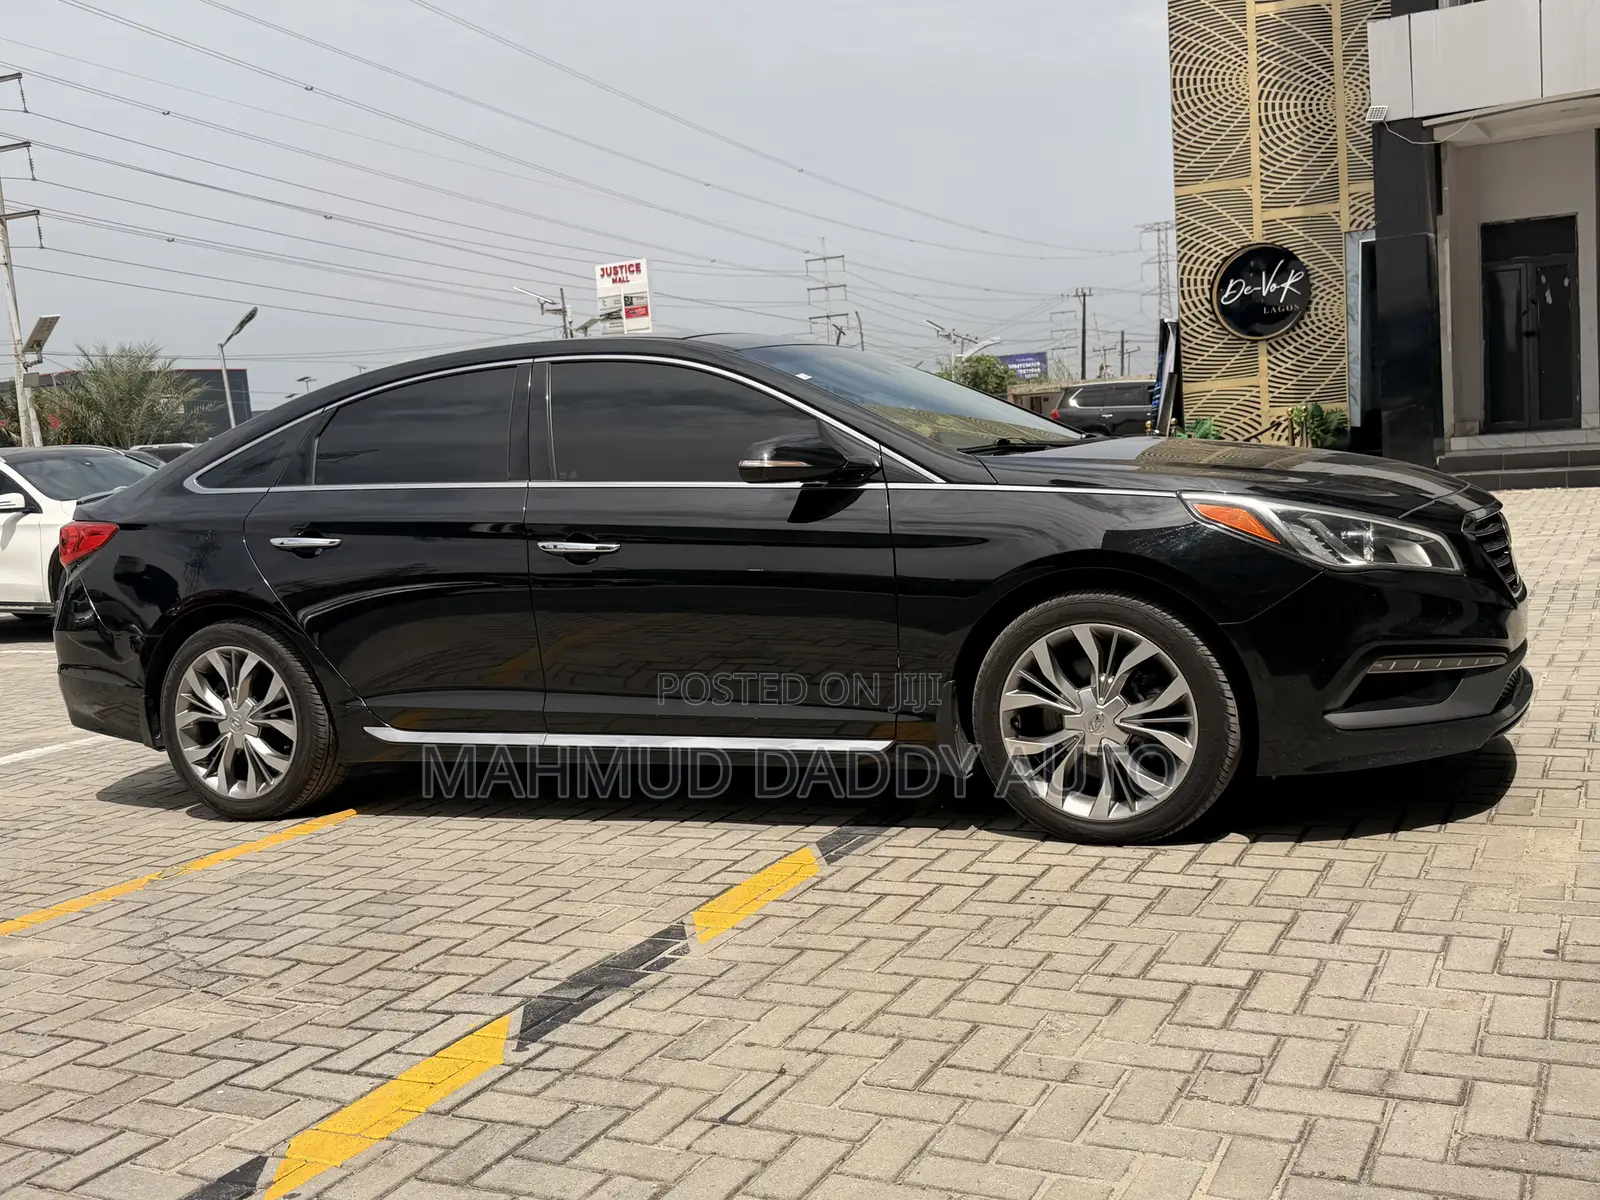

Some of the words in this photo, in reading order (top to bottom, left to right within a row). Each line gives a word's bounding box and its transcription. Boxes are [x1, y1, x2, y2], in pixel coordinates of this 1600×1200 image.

[600, 263, 641, 278] JUSTICE
[611, 276, 630, 284] MALL
[1263, 303, 1300, 314] LAGOS
